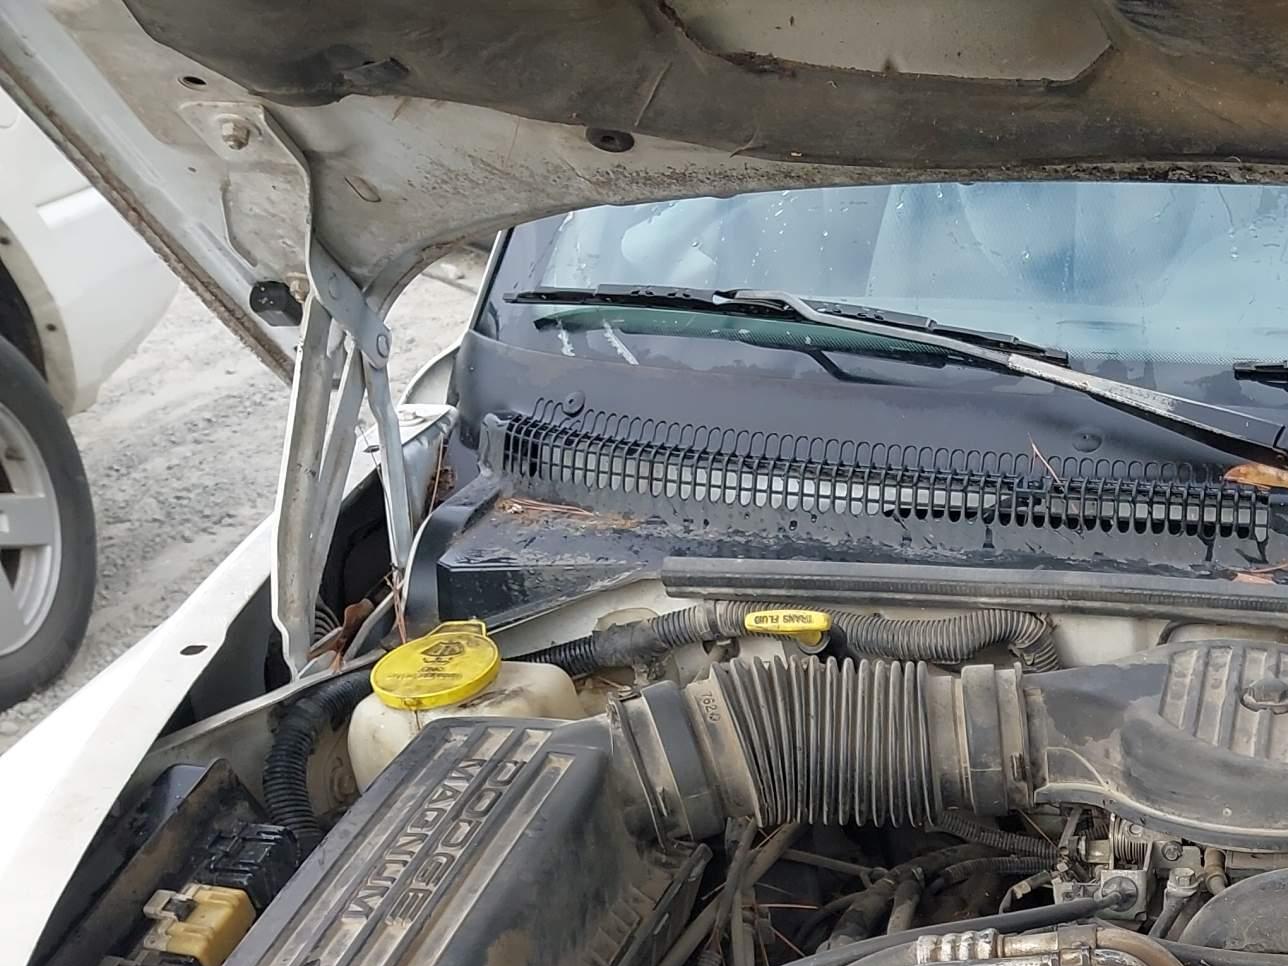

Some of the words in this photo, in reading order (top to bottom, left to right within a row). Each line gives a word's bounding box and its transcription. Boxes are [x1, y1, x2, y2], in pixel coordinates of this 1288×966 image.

[754, 615, 779, 624] FLUID
[783, 614, 813, 624] TRANS
[342, 758, 487, 921] MAGNUM
[386, 759, 527, 926] DODGE
